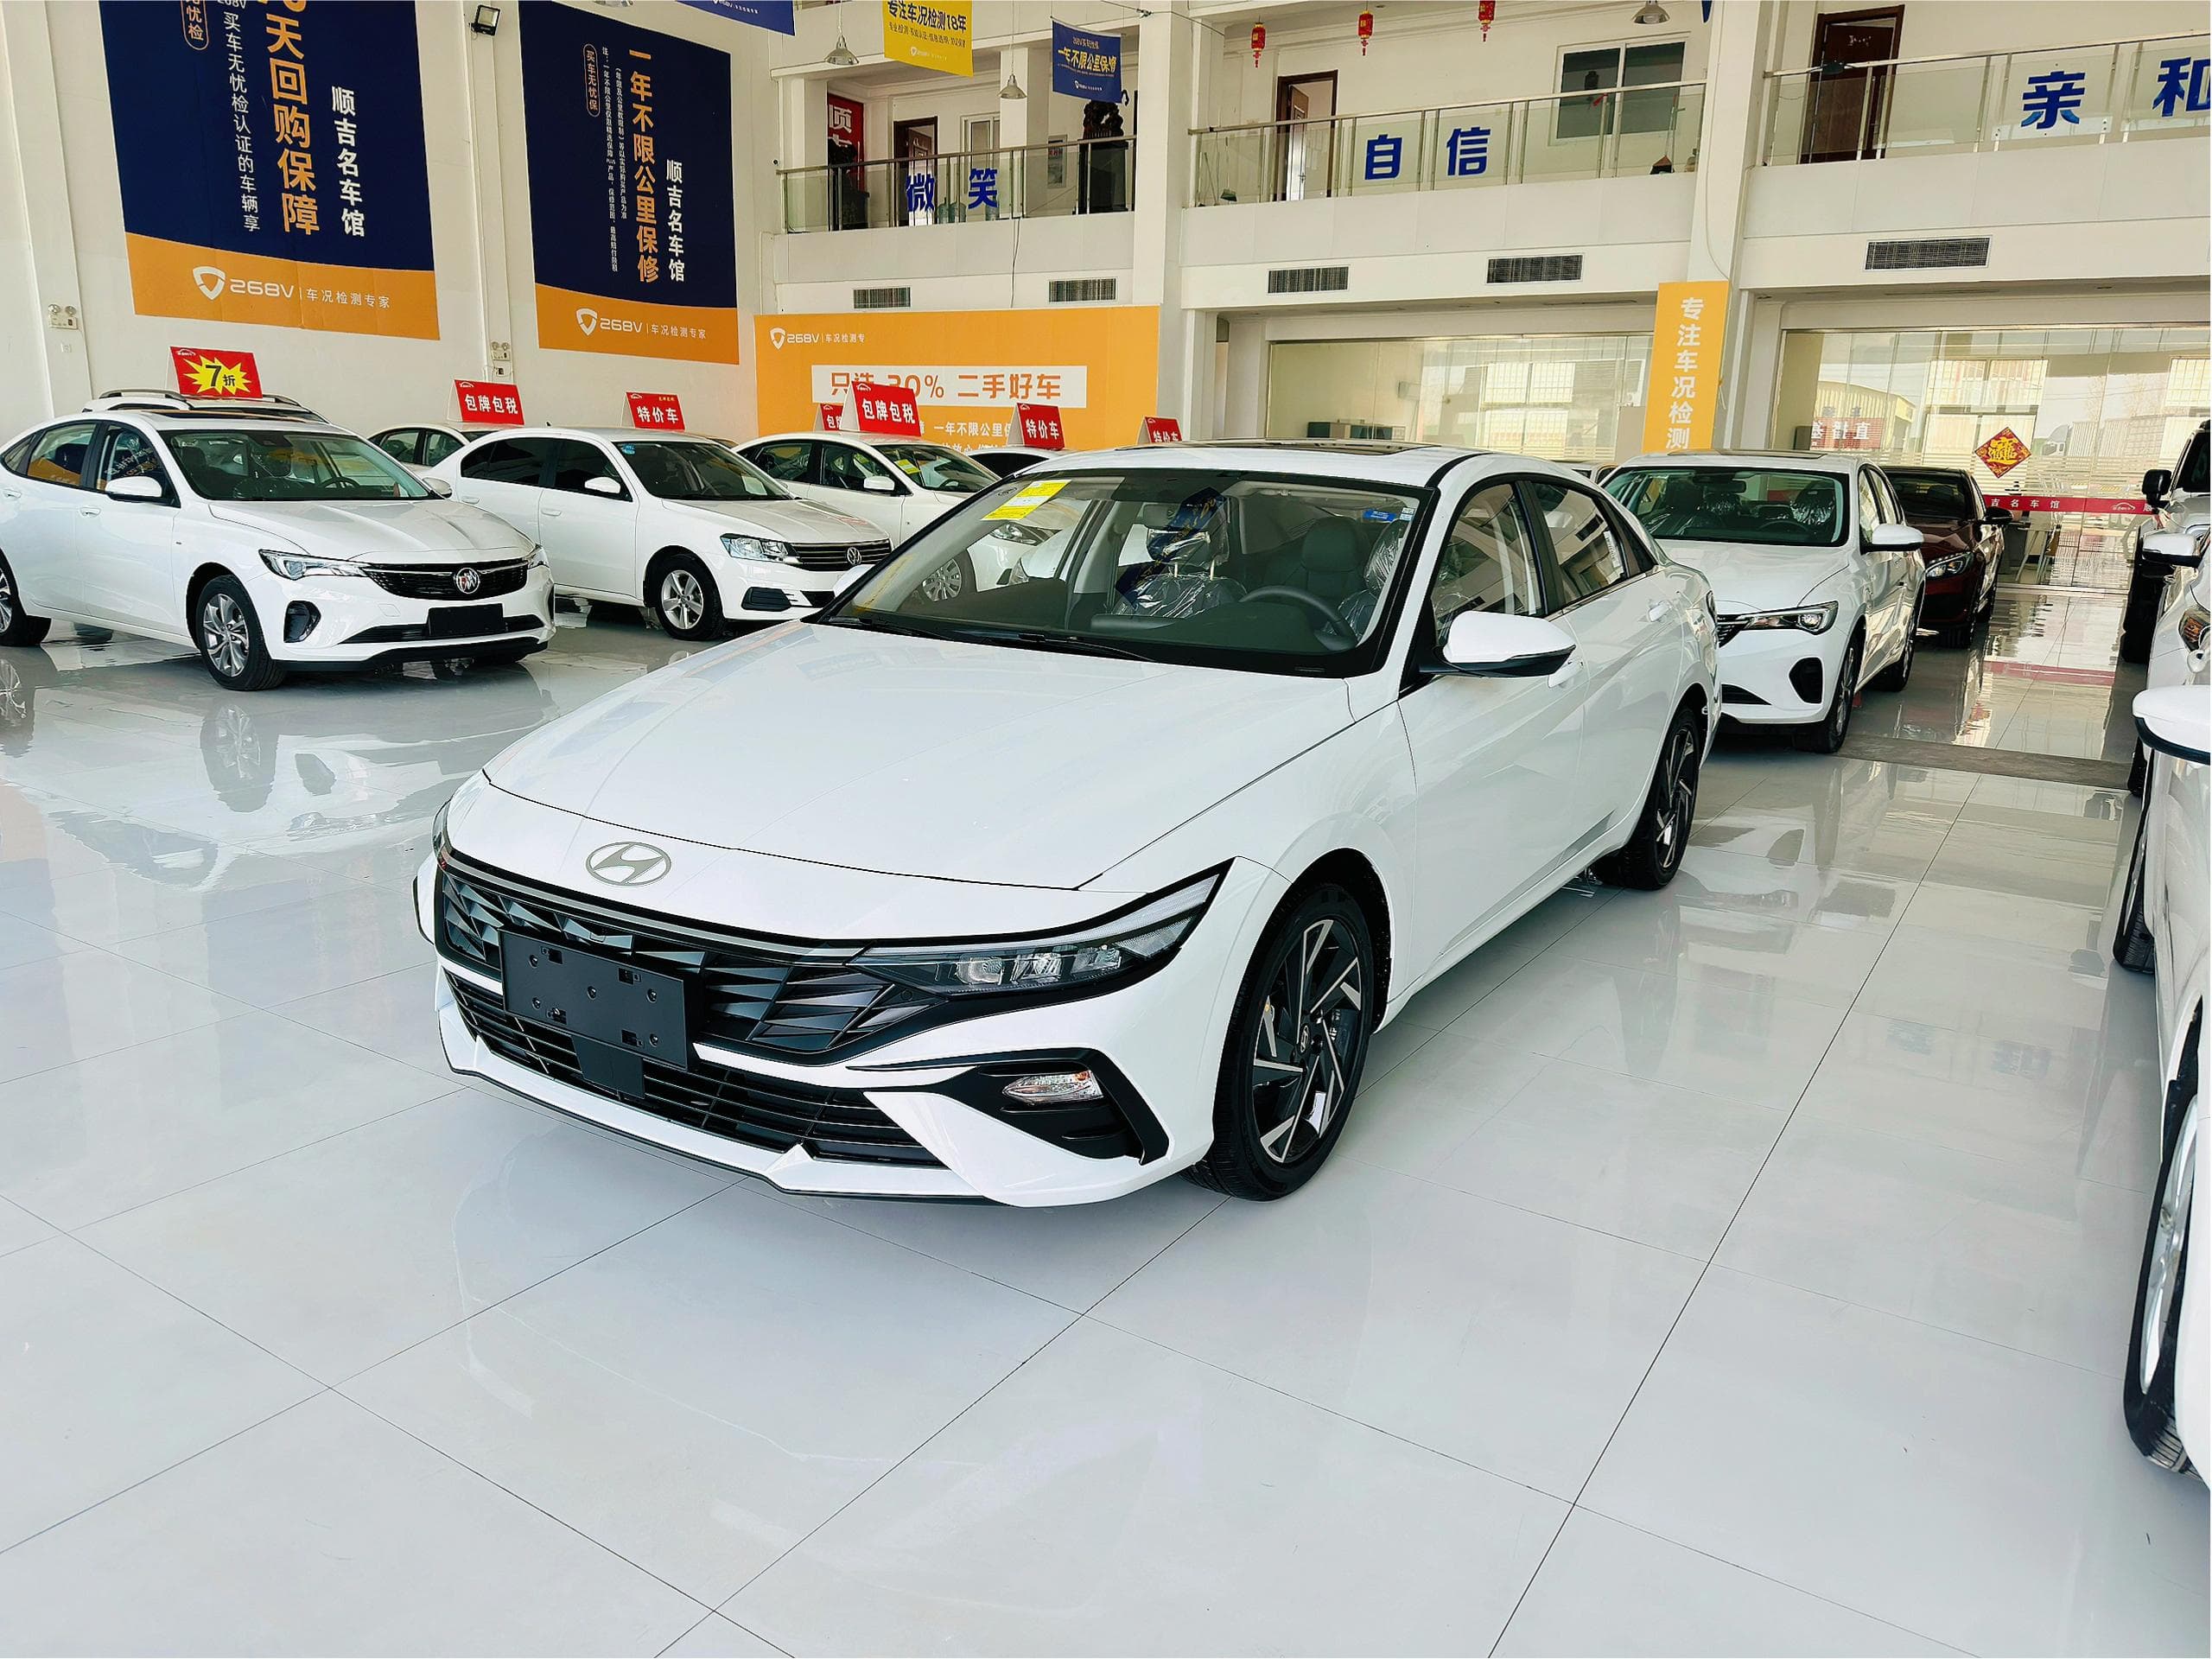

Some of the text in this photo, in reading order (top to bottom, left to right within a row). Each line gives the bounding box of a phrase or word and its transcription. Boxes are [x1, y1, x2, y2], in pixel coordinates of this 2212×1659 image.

[183, 0, 204, 41] 忧检
[887, 0, 967, 34] 专注车况检测18年
[586, 49, 598, 111] 买车无忧保
[331, 86, 365, 237] 顺吉名车馆
[628, 49, 659, 283] 一年不限公里保修
[666, 159, 685, 283] 顺吉名车馆
[230, 277, 391, 308] 268V 车况检测专家
[601, 317, 707, 340] 268V 车况检测专家
[787, 333, 820, 344] 268V
[206, 364, 235, 387] 7折
[957, 372, 1062, 399] 二手好车
[1665, 296, 1705, 449] 专注车况检测
[464, 394, 518, 415] 包牌包税
[637, 406, 678, 423] 特价车
[861, 398, 916, 424] 包牌包税
[1026, 419, 1060, 440] 特价车
[1990, 498, 2061, 510] 吉名车馆
